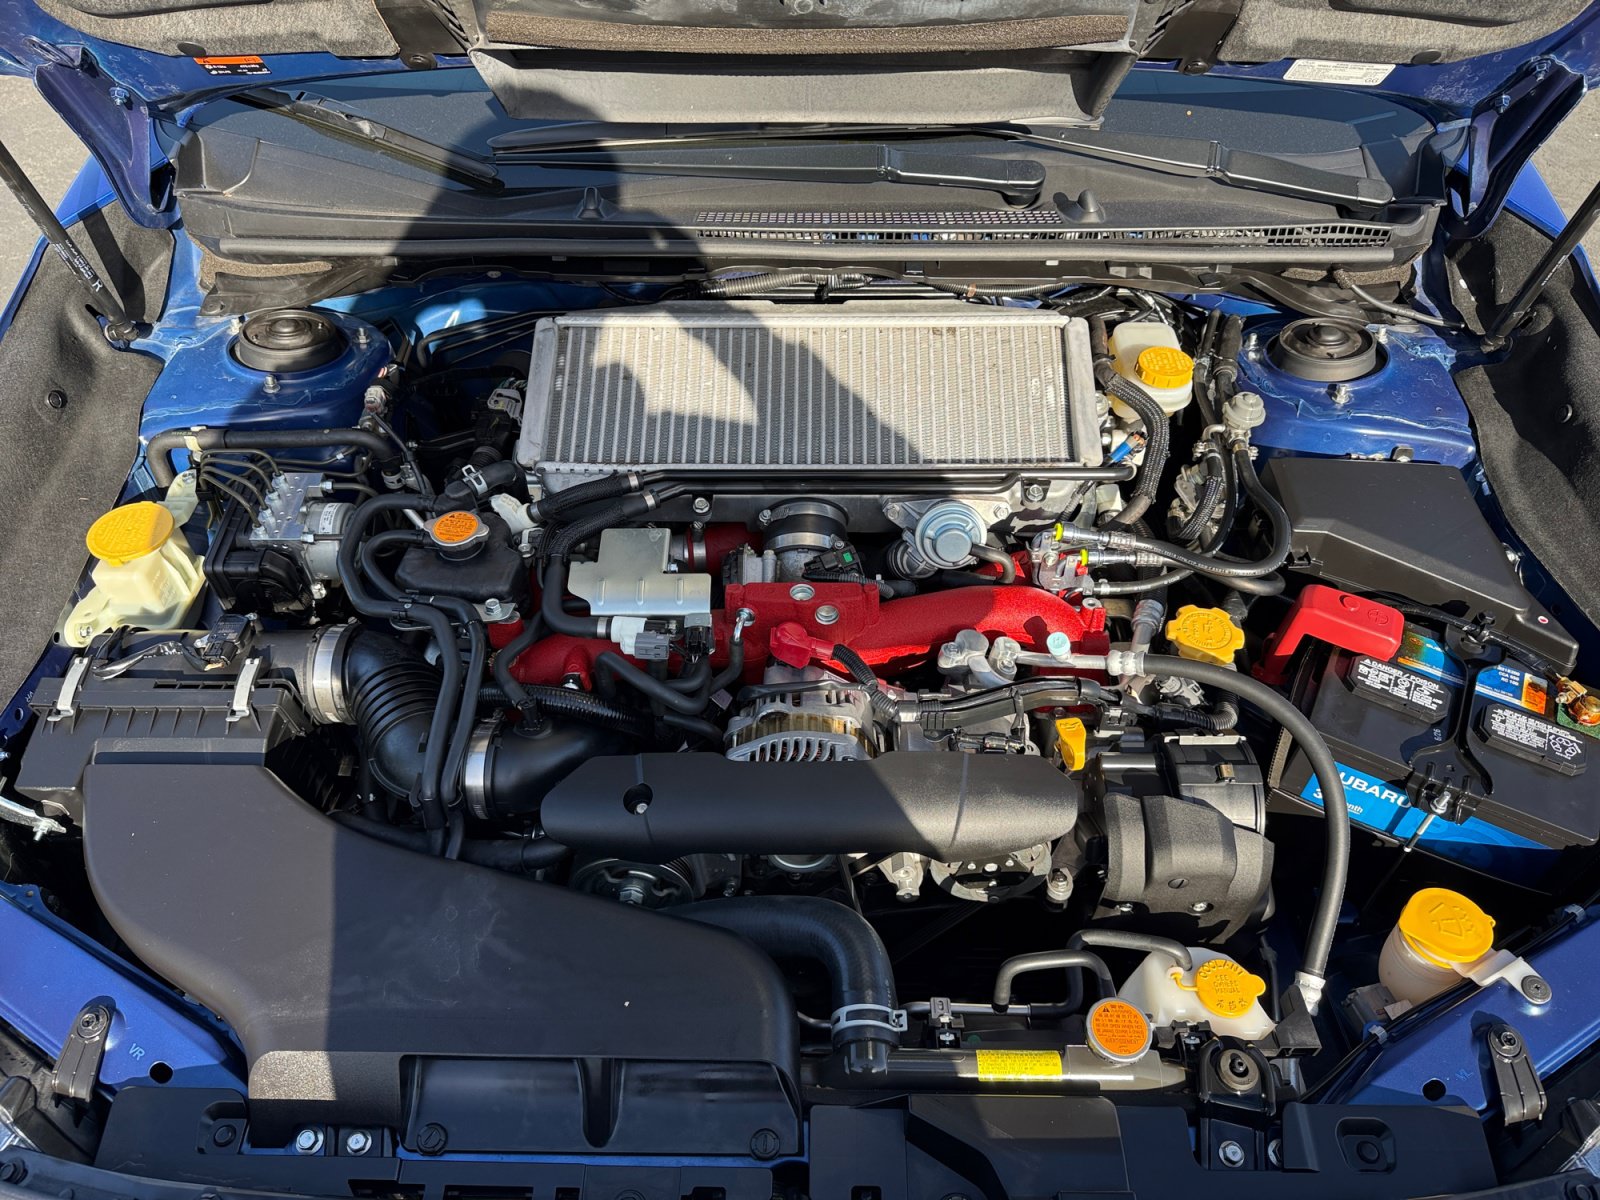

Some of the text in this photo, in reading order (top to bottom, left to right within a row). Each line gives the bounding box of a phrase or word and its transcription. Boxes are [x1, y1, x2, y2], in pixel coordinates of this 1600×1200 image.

[1370, 661, 1403, 676] DANGER
[1409, 674, 1439, 690] POISON
[1339, 771, 1412, 809] UBARU
[128, 1042, 146, 1061] VR
